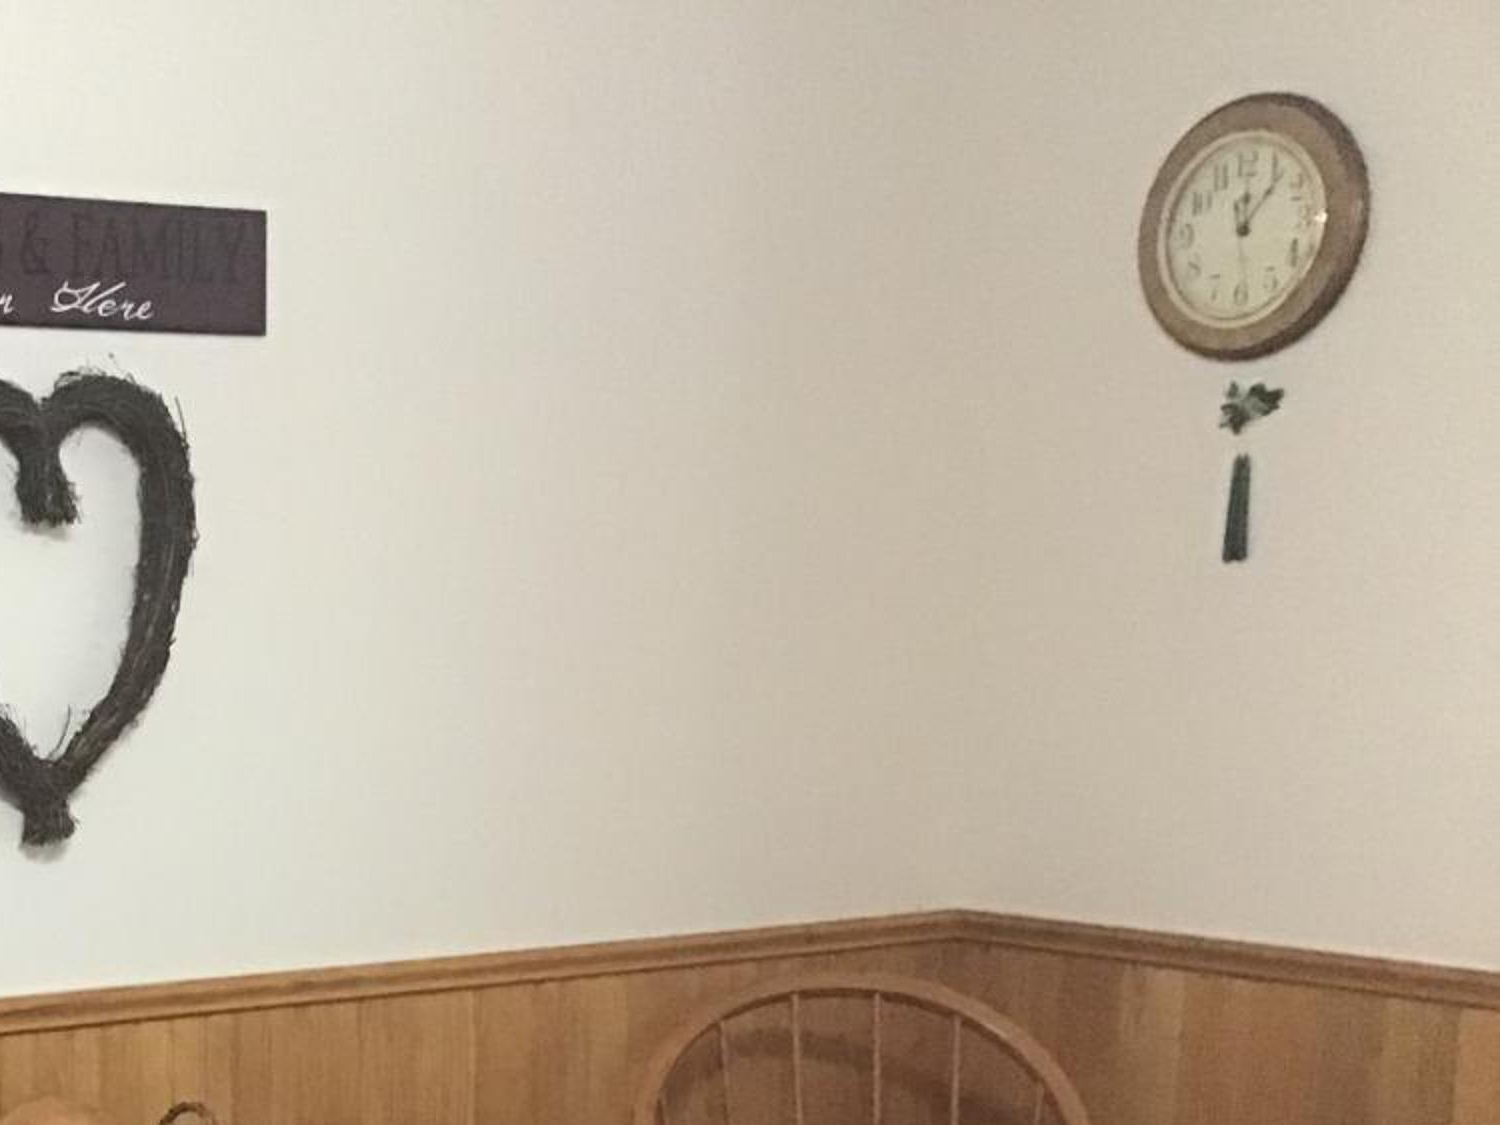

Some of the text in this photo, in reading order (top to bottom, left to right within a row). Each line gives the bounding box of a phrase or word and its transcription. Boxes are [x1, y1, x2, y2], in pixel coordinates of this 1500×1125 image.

[1213, 163, 1229, 191] 11
[1237, 151, 1259, 178] 12
[1192, 190, 1213, 216] 10
[1178, 223, 1195, 249] 9
[21, 213, 50, 276] &
[73, 213, 249, 288] FAMILY
[51, 280, 155, 320] Here
[1207, 274, 1221, 301] 7
[1233, 282, 1249, 306] 6
